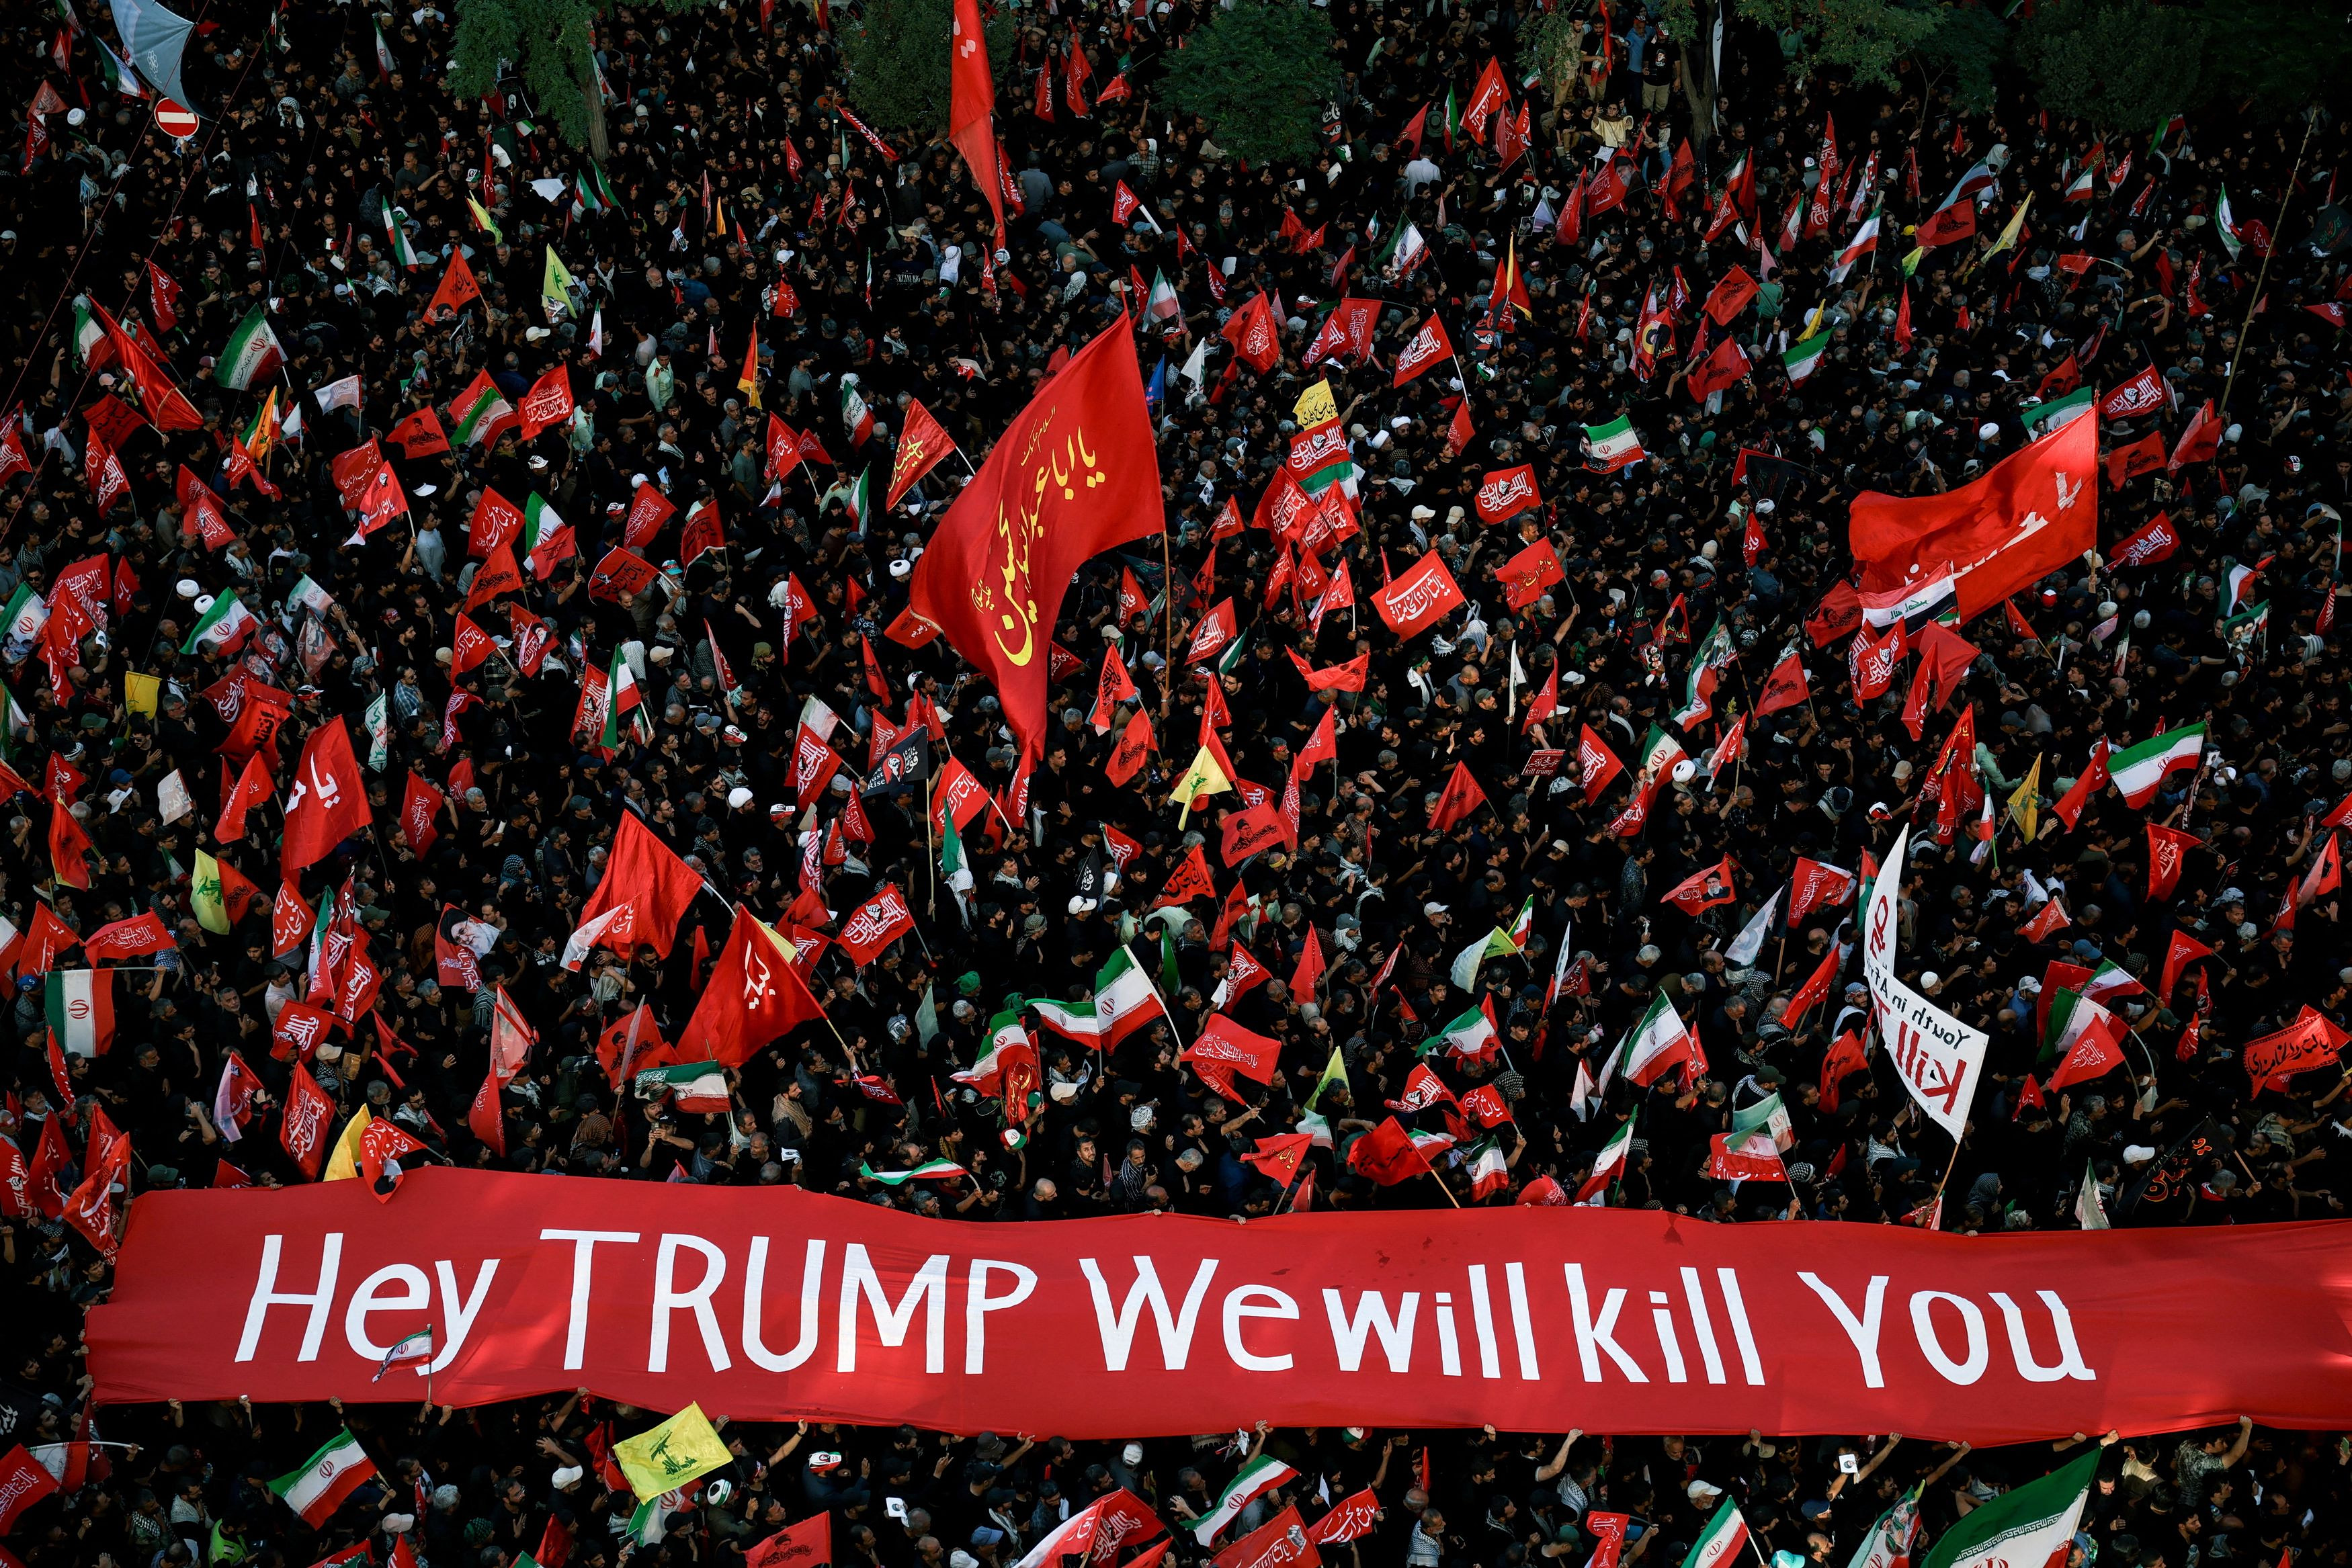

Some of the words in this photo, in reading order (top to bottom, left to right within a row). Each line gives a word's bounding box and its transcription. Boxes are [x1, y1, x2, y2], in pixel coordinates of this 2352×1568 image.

[867, 779, 885, 791] Rise
[235, 1233, 500, 1375] Hey
[540, 1229, 1038, 1374] TRUMP
[1079, 1255, 1299, 1372] We
[1322, 1262, 1540, 1381] will
[1564, 1262, 1765, 1386] kill
[1796, 1271, 2097, 1389] You
